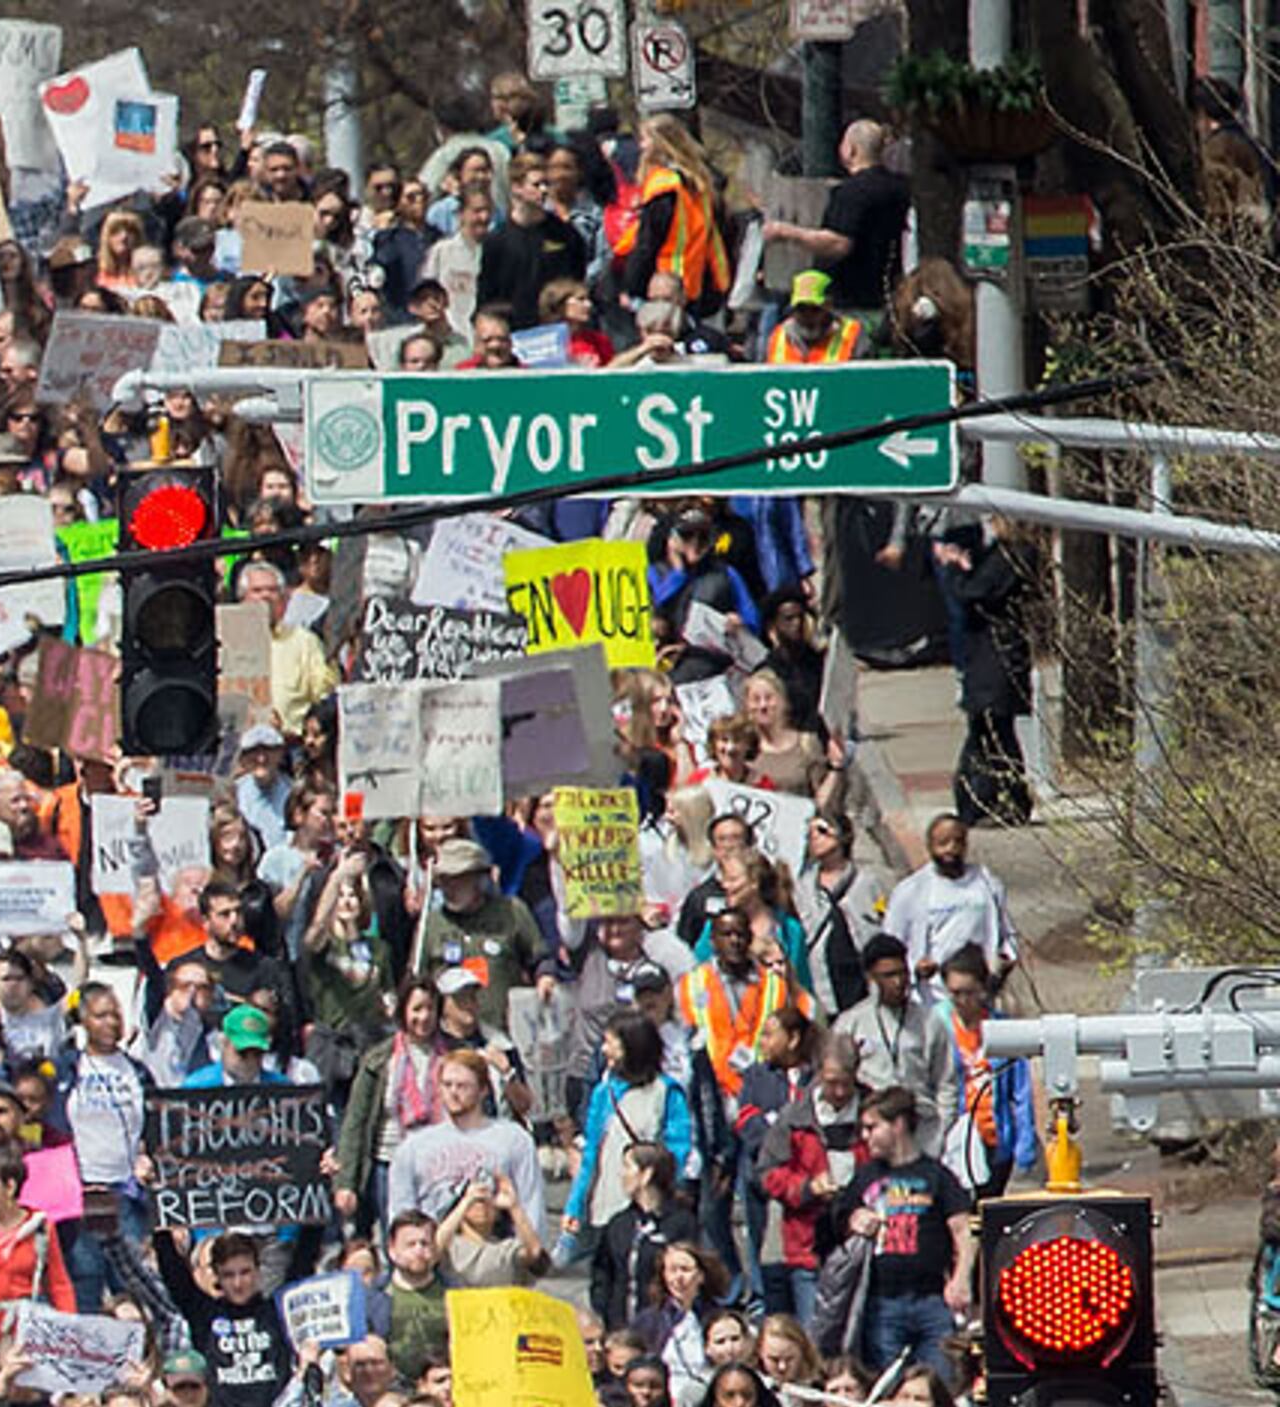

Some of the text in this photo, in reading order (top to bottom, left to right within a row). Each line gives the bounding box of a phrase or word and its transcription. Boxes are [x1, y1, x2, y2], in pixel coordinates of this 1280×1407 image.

[542, 9, 610, 55] 30
[396, 389, 818, 494] Pryor St SW
[158, 1190, 329, 1228] REFORM
